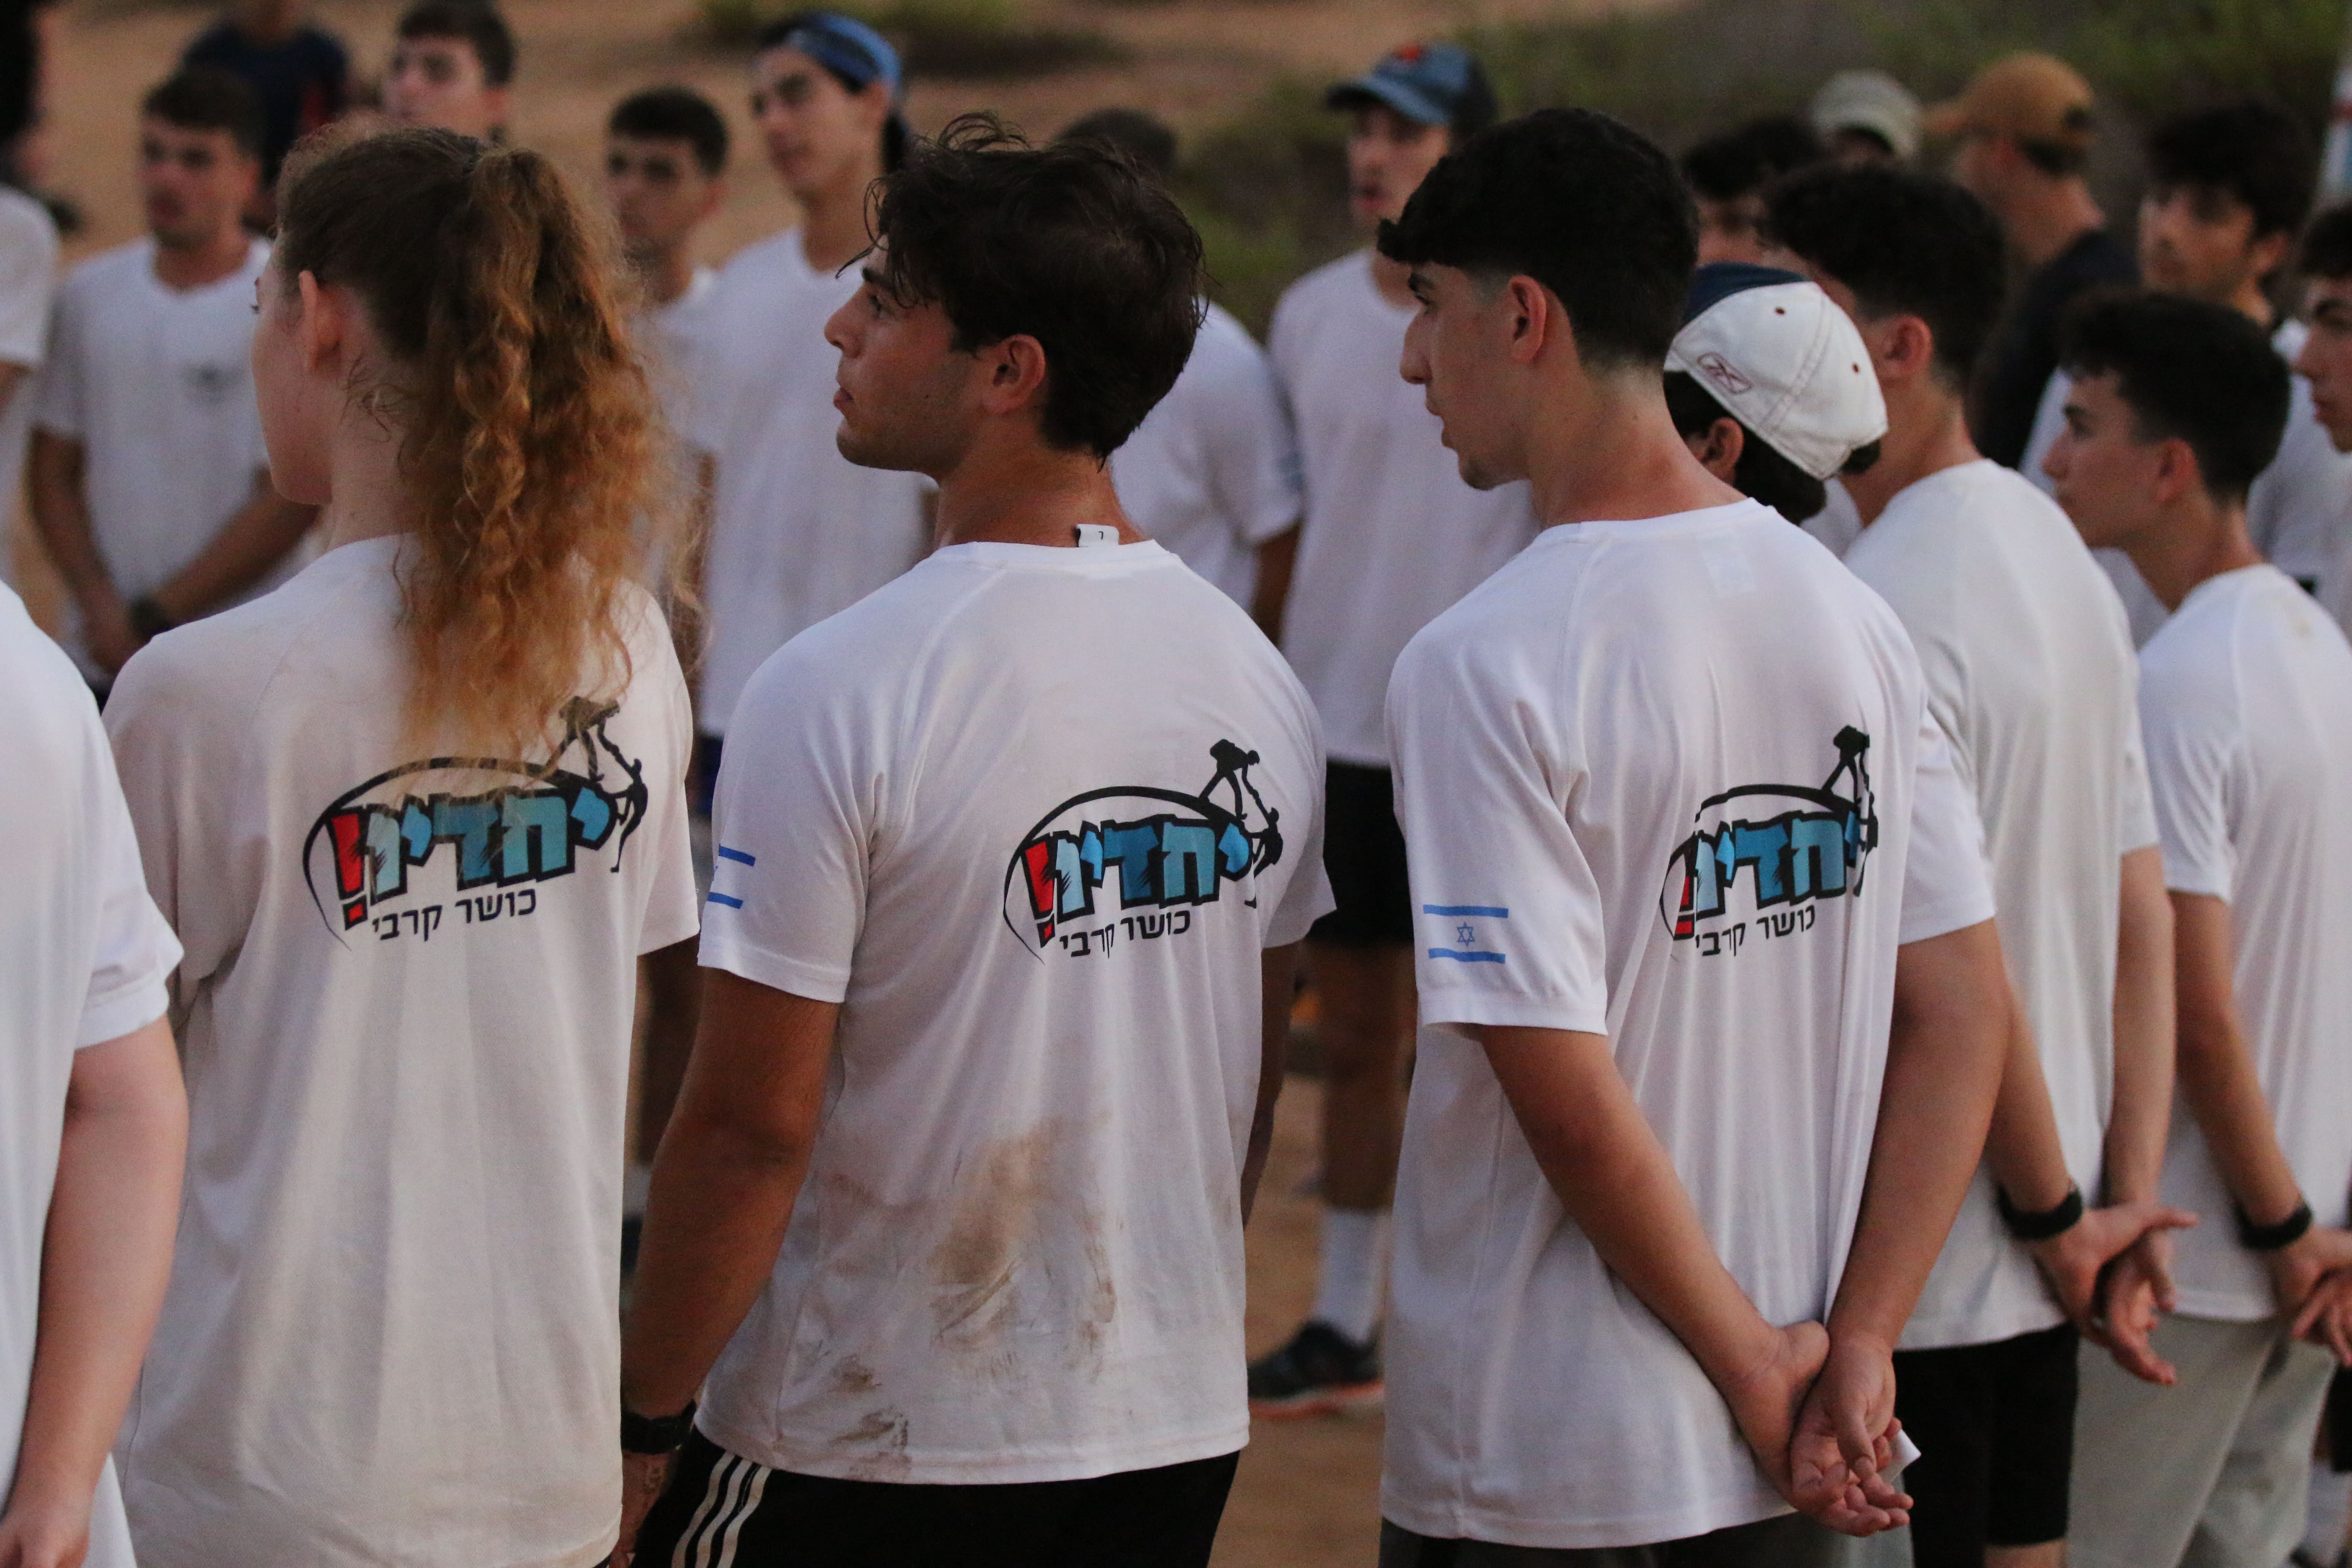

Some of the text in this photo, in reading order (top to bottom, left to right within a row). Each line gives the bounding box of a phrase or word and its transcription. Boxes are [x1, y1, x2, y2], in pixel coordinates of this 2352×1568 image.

[372, 888, 537, 942] כושר קרבי
[1059, 910, 1191, 959] כושר קרבי
[1695, 905, 1816, 957] כושר קרבי
